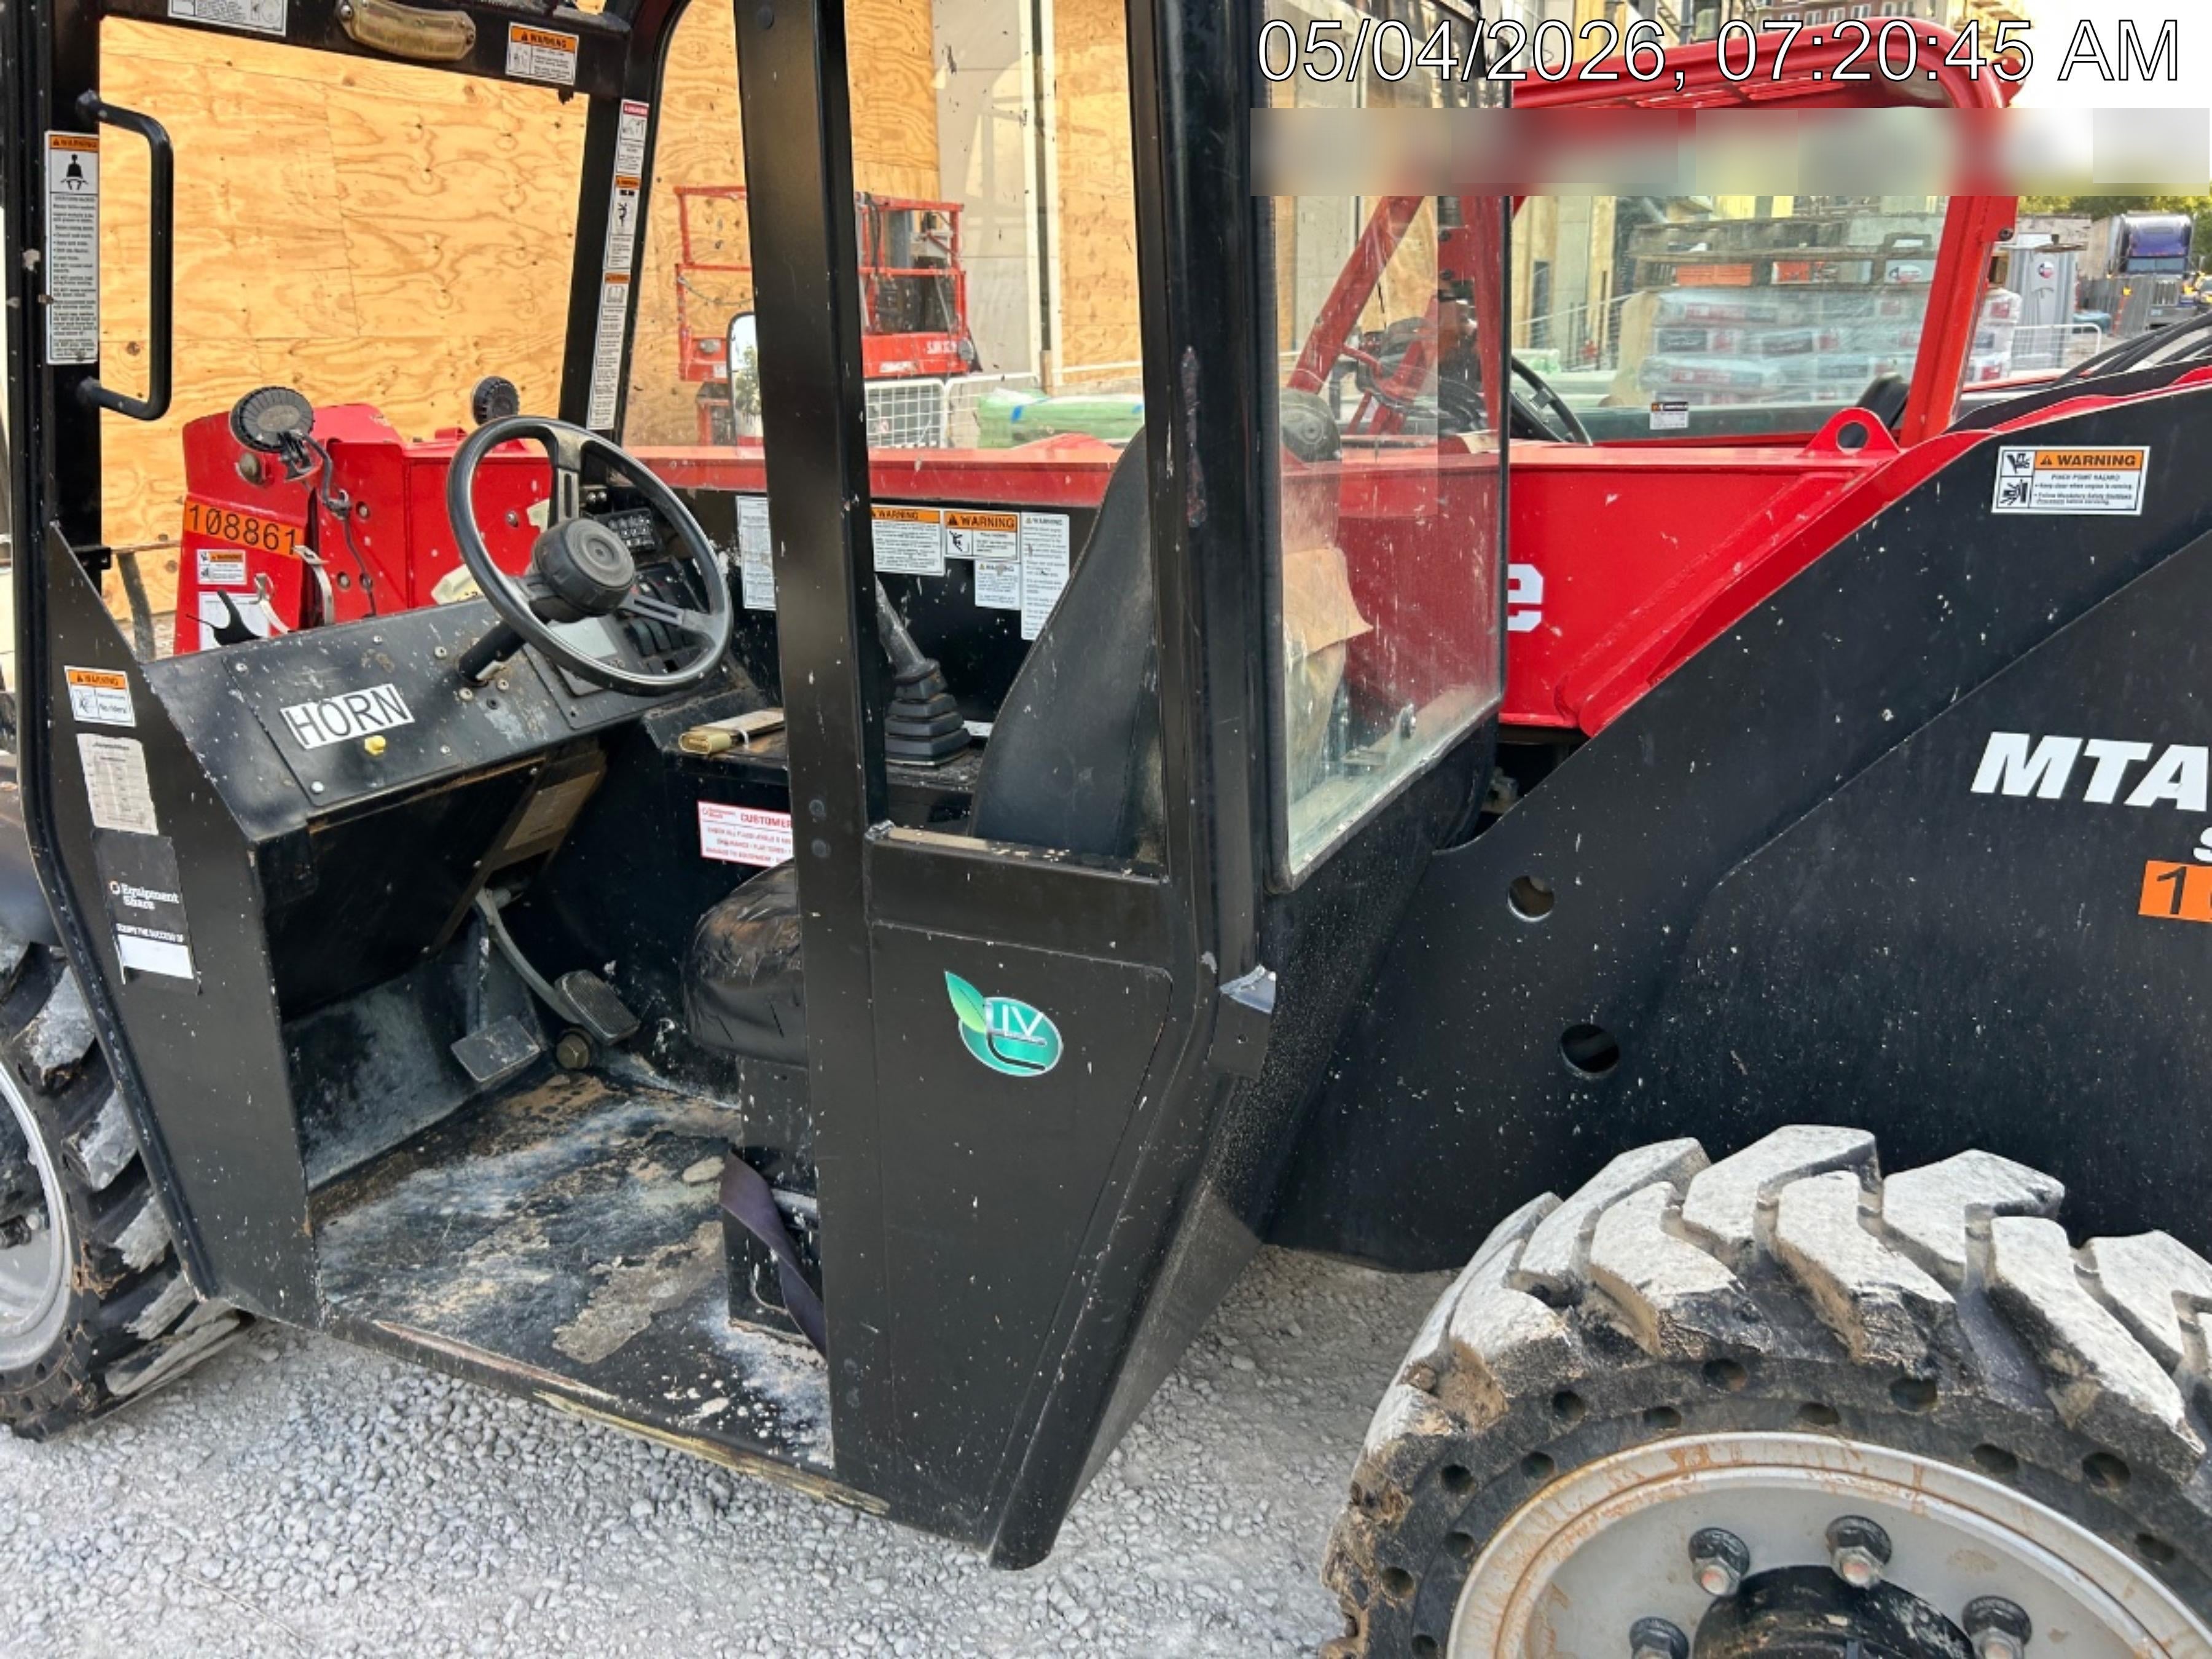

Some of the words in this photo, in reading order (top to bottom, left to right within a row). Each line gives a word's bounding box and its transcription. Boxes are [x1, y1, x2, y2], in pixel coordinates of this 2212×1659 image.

[2057, 455, 2136, 466] WARNING
[879, 509, 919, 520] WARNING
[961, 515, 1015, 529] WARNING
[188, 504, 297, 556] 108861
[286, 685, 409, 748] HORN
[1971, 731, 2209, 812] MTA
[120, 882, 179, 904] Equipment
